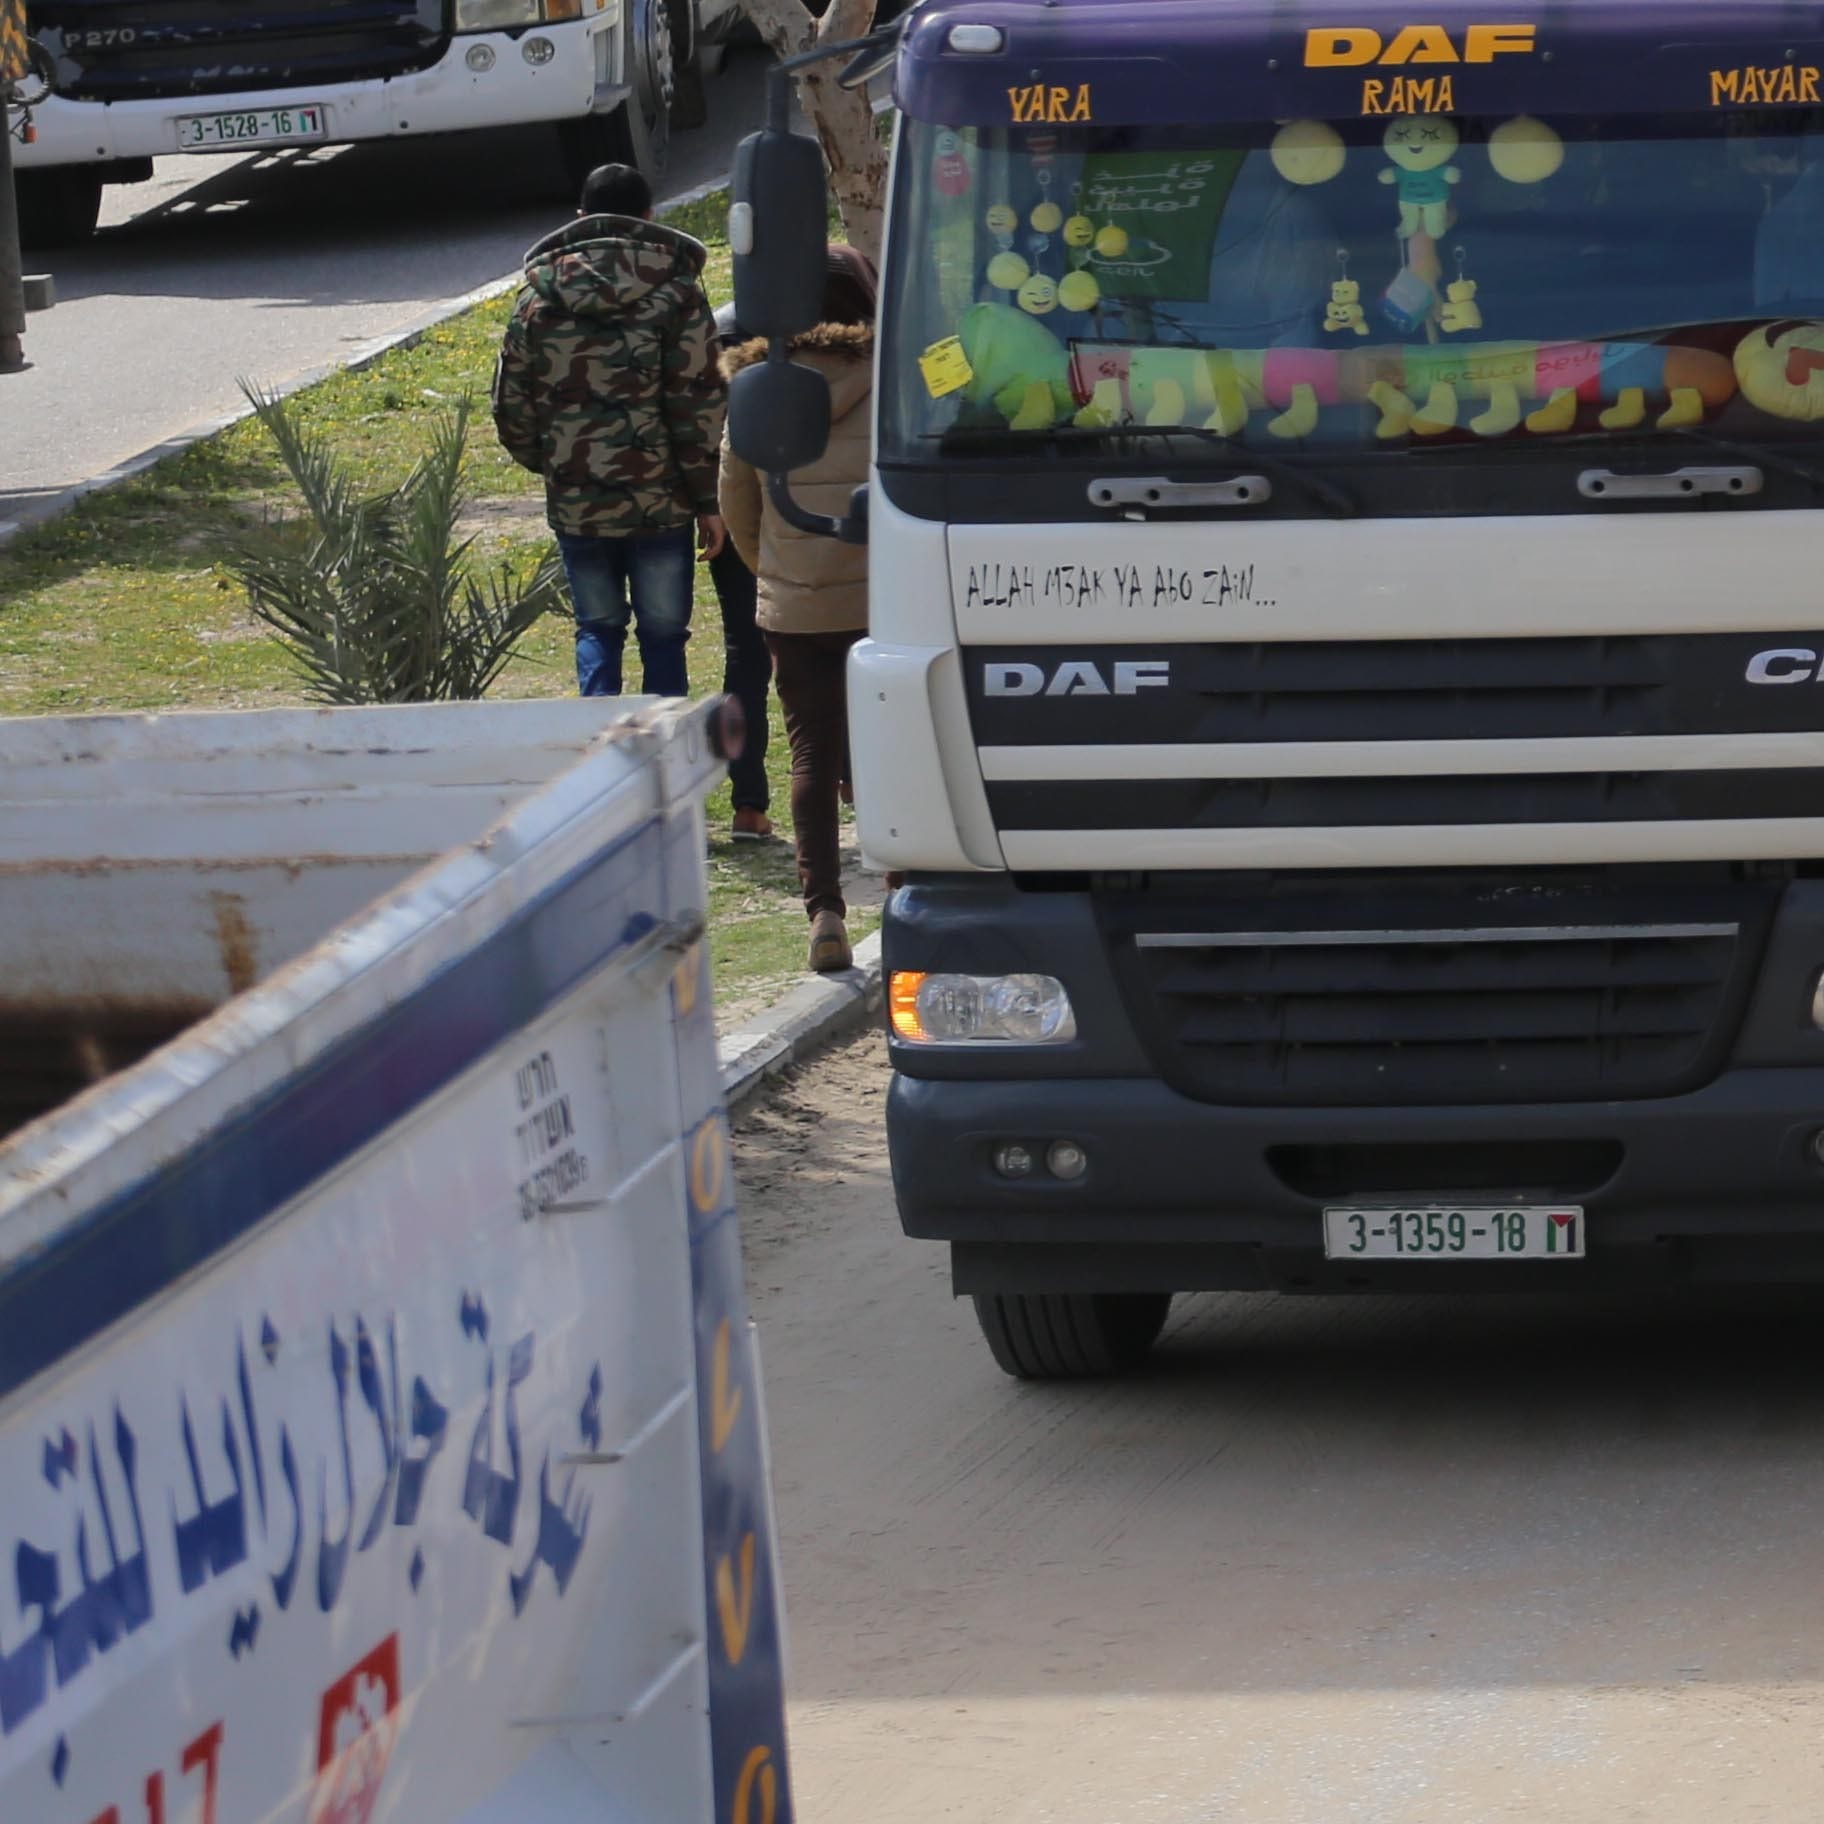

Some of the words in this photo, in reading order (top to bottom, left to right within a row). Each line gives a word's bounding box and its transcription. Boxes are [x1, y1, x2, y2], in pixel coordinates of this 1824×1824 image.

[64, 33, 82, 49] P
[85, 28, 137, 46] 270
[1304, 25, 1535, 67] DAF
[1008, 84, 1092, 123] YARA
[1361, 76, 1455, 114] RAMA
[1710, 66, 1821, 107] MAYAR
[966, 564, 1035, 608] ALLAH
[1114, 565, 1142, 608] YA
[984, 661, 1170, 696] DAF
